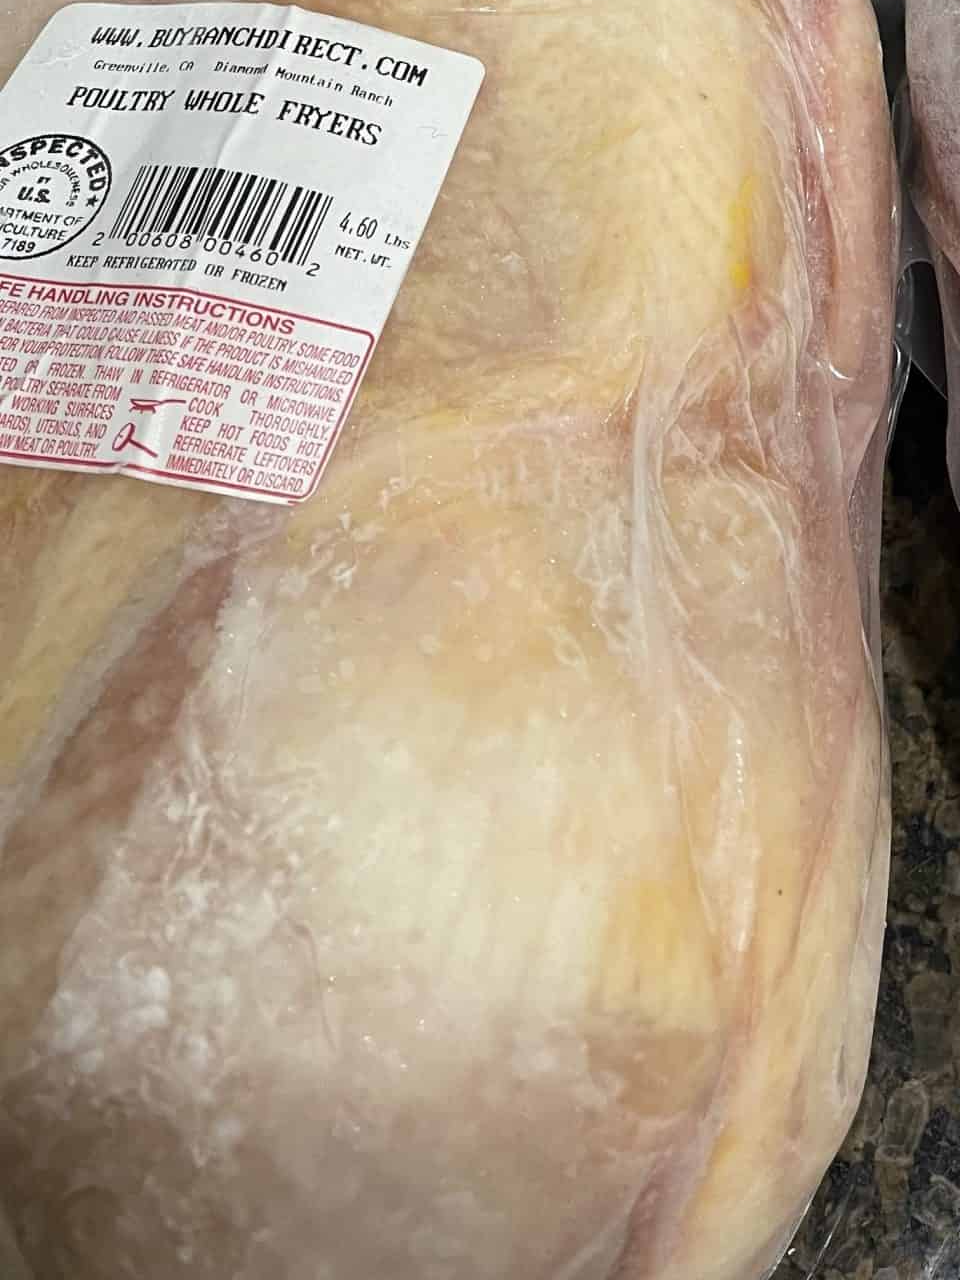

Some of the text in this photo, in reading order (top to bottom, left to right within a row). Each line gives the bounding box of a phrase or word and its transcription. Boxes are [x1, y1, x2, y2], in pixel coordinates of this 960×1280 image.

[91, 26, 429, 87] WWW.BUYRANCHDIRECT.COM
[179, 61, 194, 72] CA
[214, 61, 268, 75] Diamond
[275, 67, 344, 93] Mountain
[350, 85, 393, 108] Ranch
[66, 85, 383, 147] POULTRY WHOLE FRYERS
[64, 216, 85, 227] OF
[2, 238, 36, 253] 7189
[92, 231, 321, 277] 2 00608 00460 2
[66, 255, 288, 292] KEEP REFRIGERATED OR FROZEN
[0, 280, 296, 335] FE HANDLING INSTRUCTIONS
[188, 397, 224, 417] COOK
[180, 415, 211, 434] KEEP
[217, 423, 245, 441] HOT
[250, 430, 290, 451] FOODS
[166, 454, 239, 480] IMMEDIATELY
[236, 467, 255, 483] OR
[173, 434, 317, 476] REFRIGERATE LEFTOVERS
